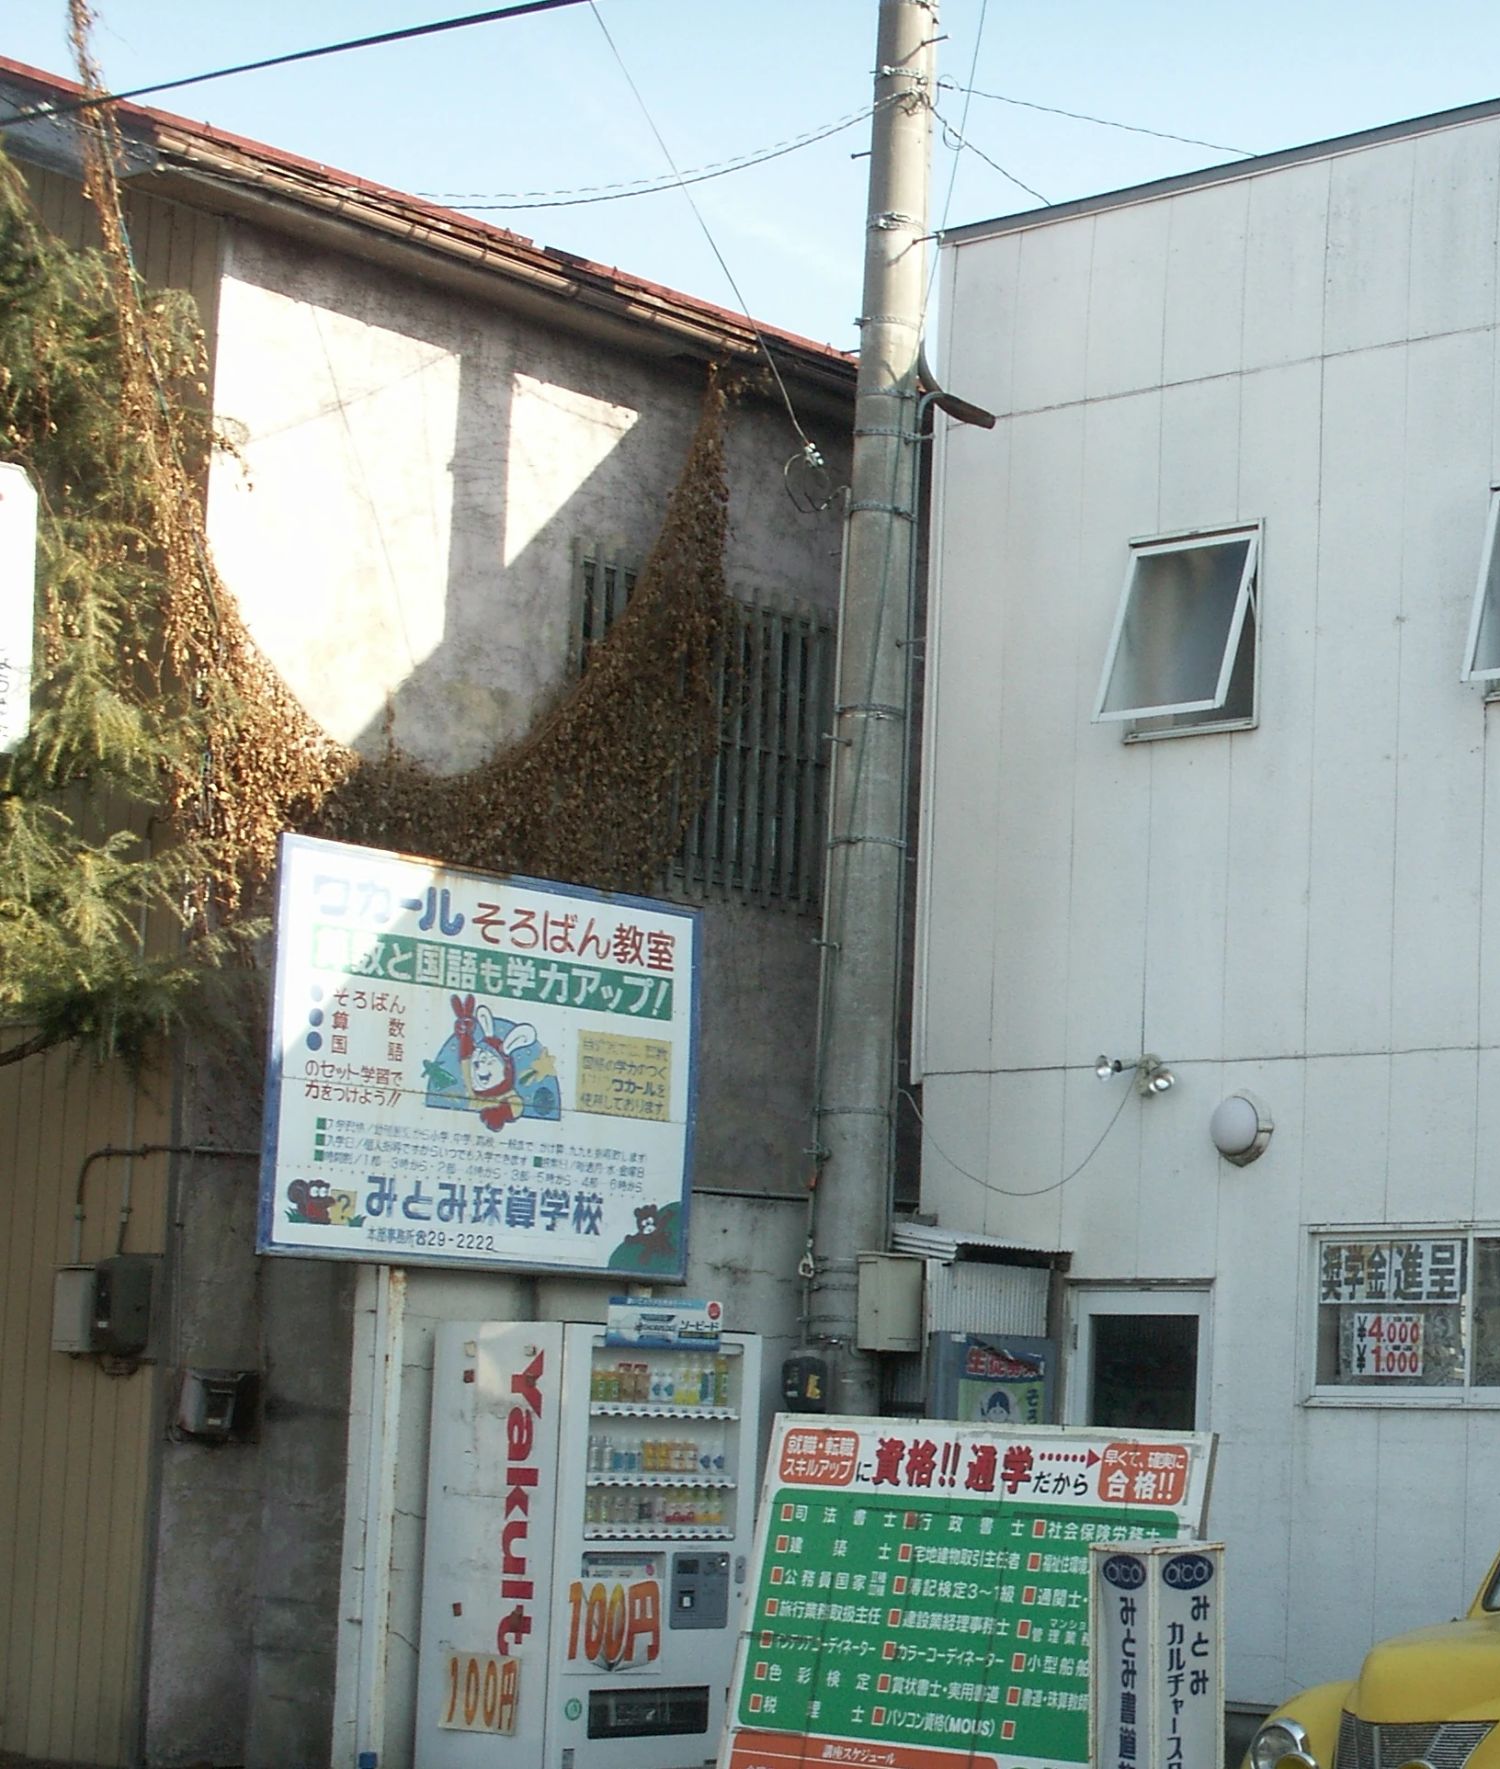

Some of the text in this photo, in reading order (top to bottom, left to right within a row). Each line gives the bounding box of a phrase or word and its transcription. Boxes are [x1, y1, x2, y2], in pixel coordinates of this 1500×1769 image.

[472, 902, 676, 972] そろばん教室
[316, 928, 668, 1018] 数と国語も学力アップ!
[333, 987, 406, 1014] そろばん
[305, 1060, 403, 1087] のセット学習で
[366, 1176, 603, 1236] みとみ珠算学校
[783, 1458, 853, 1480] スキルアップ
[1107, 1470, 1175, 1500] 合格!!
[498, 1349, 545, 1656] Yakult
[568, 1580, 661, 1662] 100円
[446, 1656, 517, 1731] 100円
